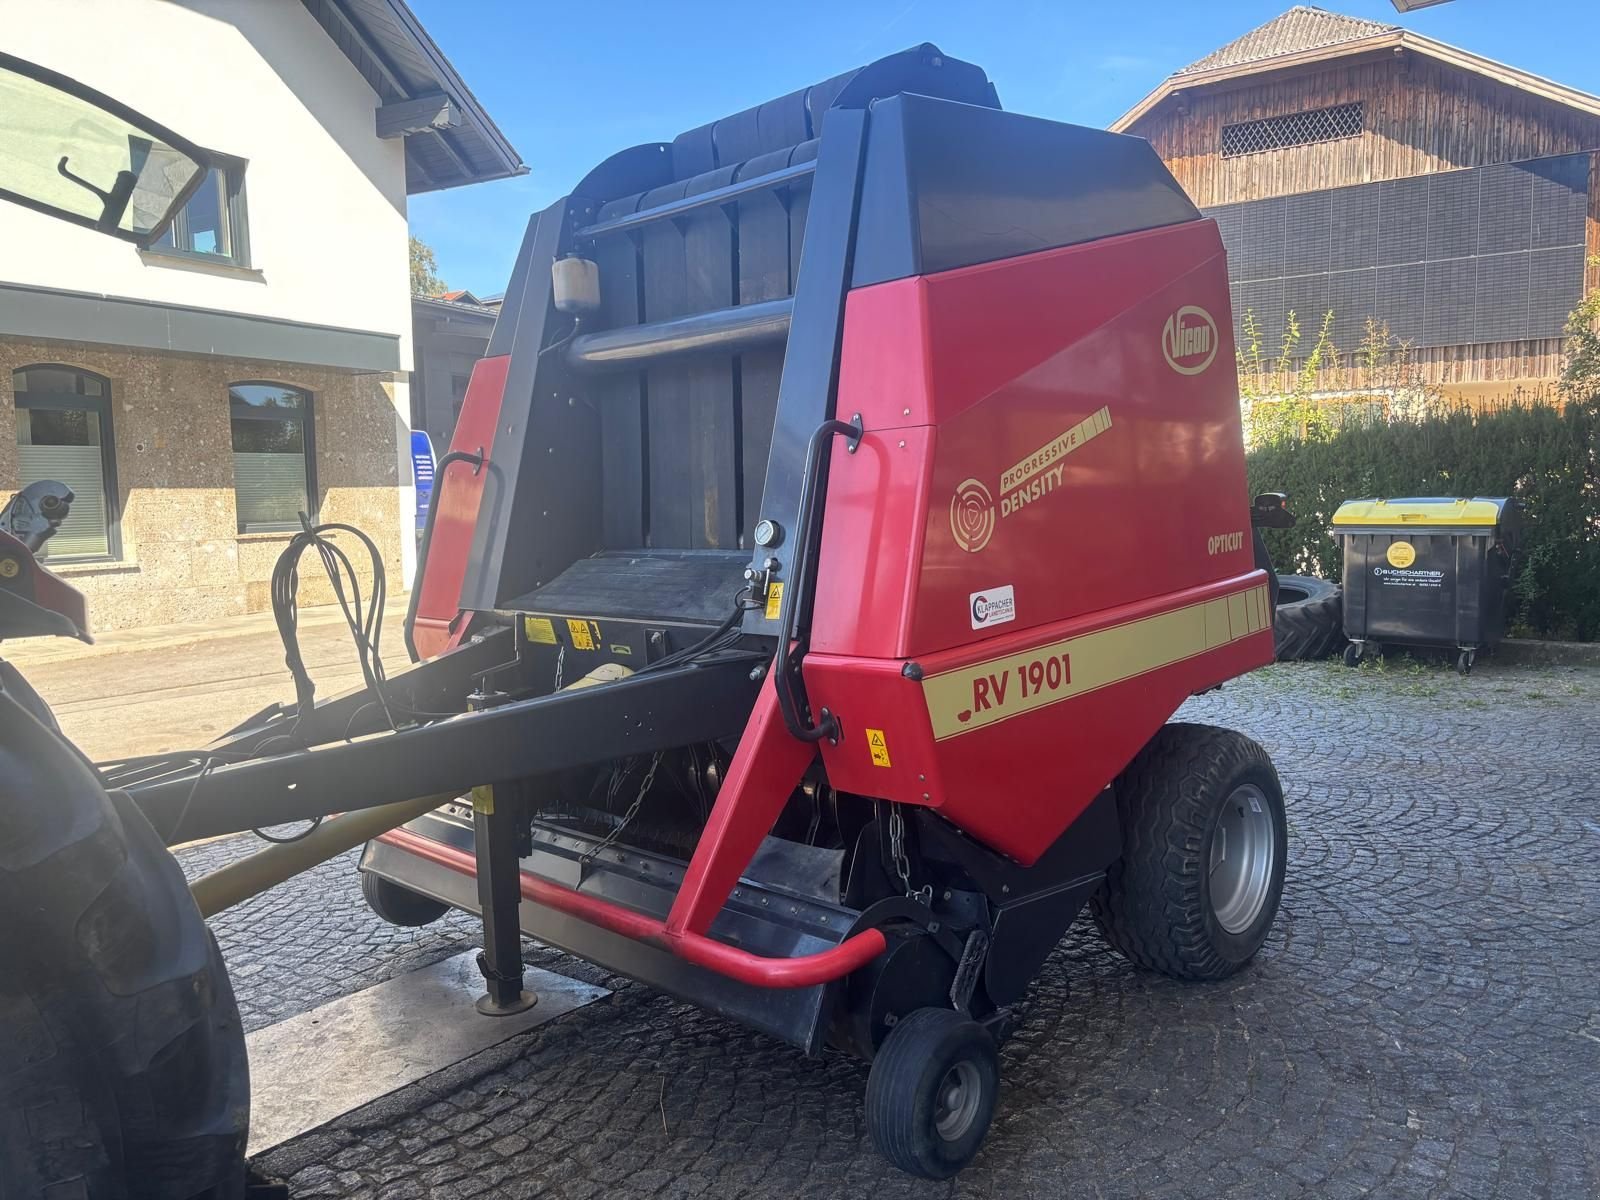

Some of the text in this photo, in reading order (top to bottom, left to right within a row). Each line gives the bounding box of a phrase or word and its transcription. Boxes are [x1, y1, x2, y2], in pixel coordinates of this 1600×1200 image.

[1166, 314, 1210, 358] Vicon
[1002, 434, 1077, 489] PROGRESSIVE
[1002, 463, 1065, 518] DENSITY
[1208, 532, 1243, 555] OPTICUT
[977, 598, 1012, 614] KLAPPACHER
[973, 653, 1071, 712] RV 1901
